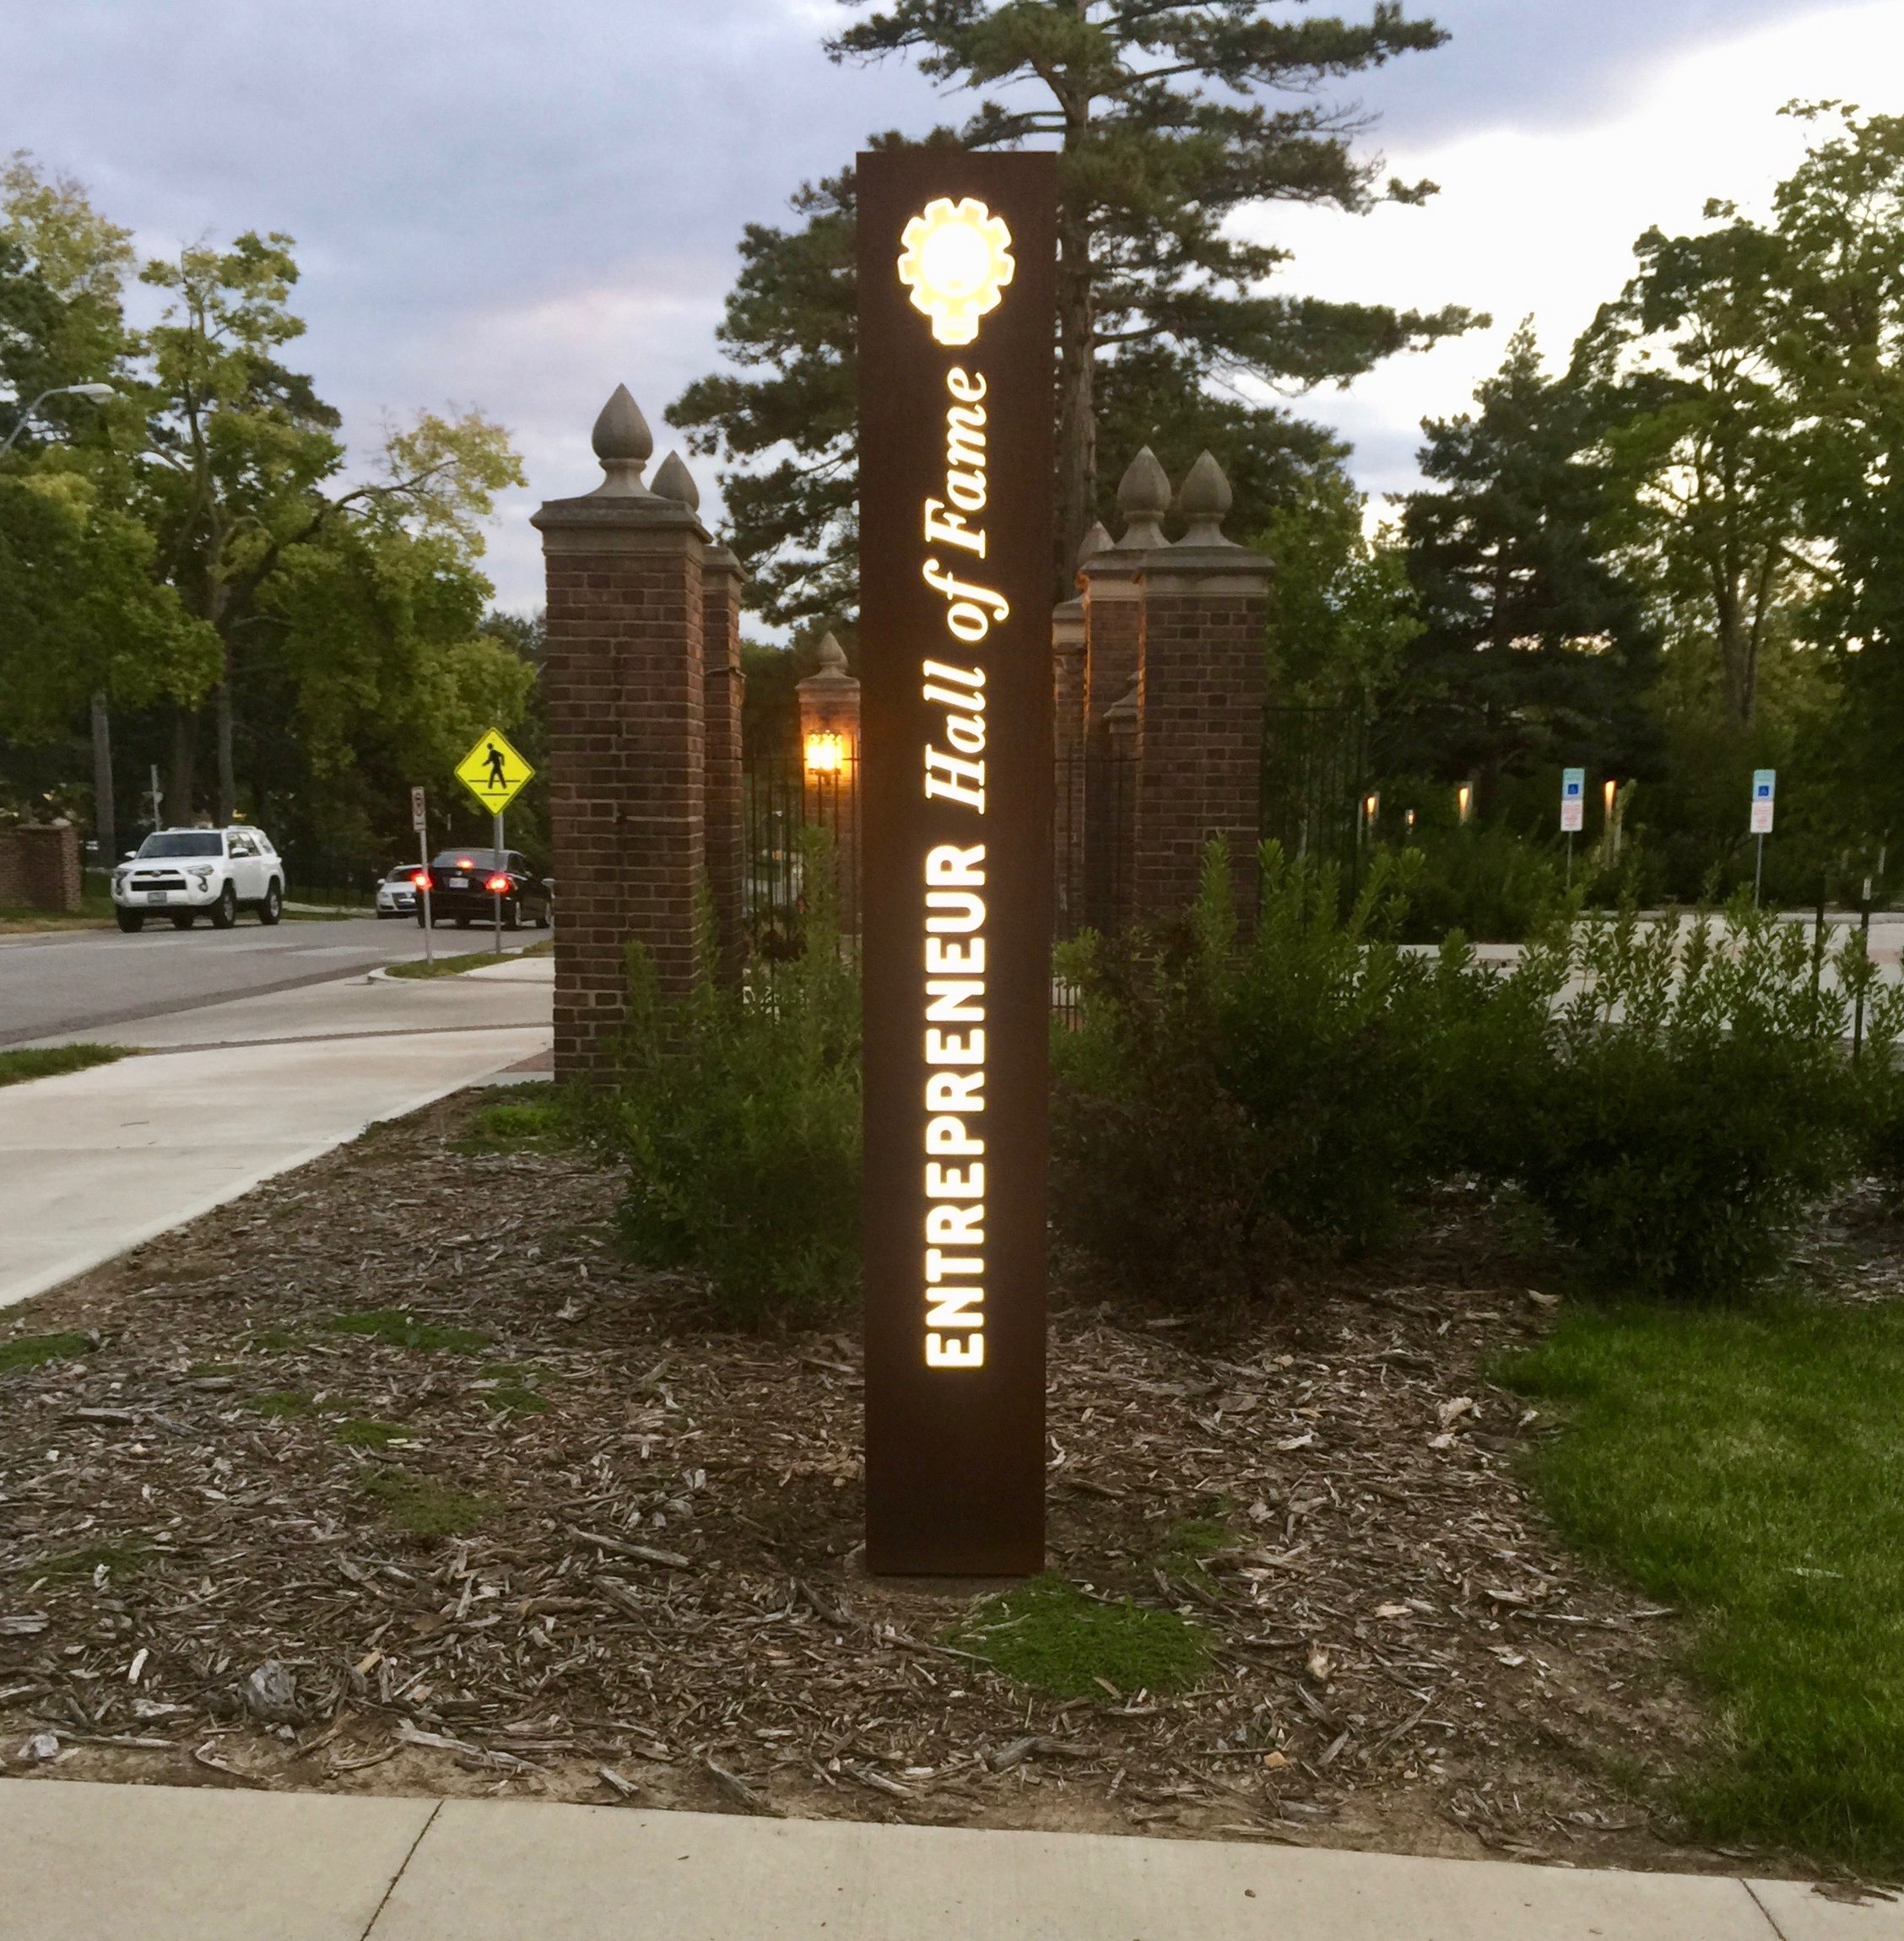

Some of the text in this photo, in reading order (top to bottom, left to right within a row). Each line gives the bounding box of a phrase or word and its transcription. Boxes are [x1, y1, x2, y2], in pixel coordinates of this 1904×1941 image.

[922, 366, 1010, 1368] ENTREPRENEUR Hall of Fame
